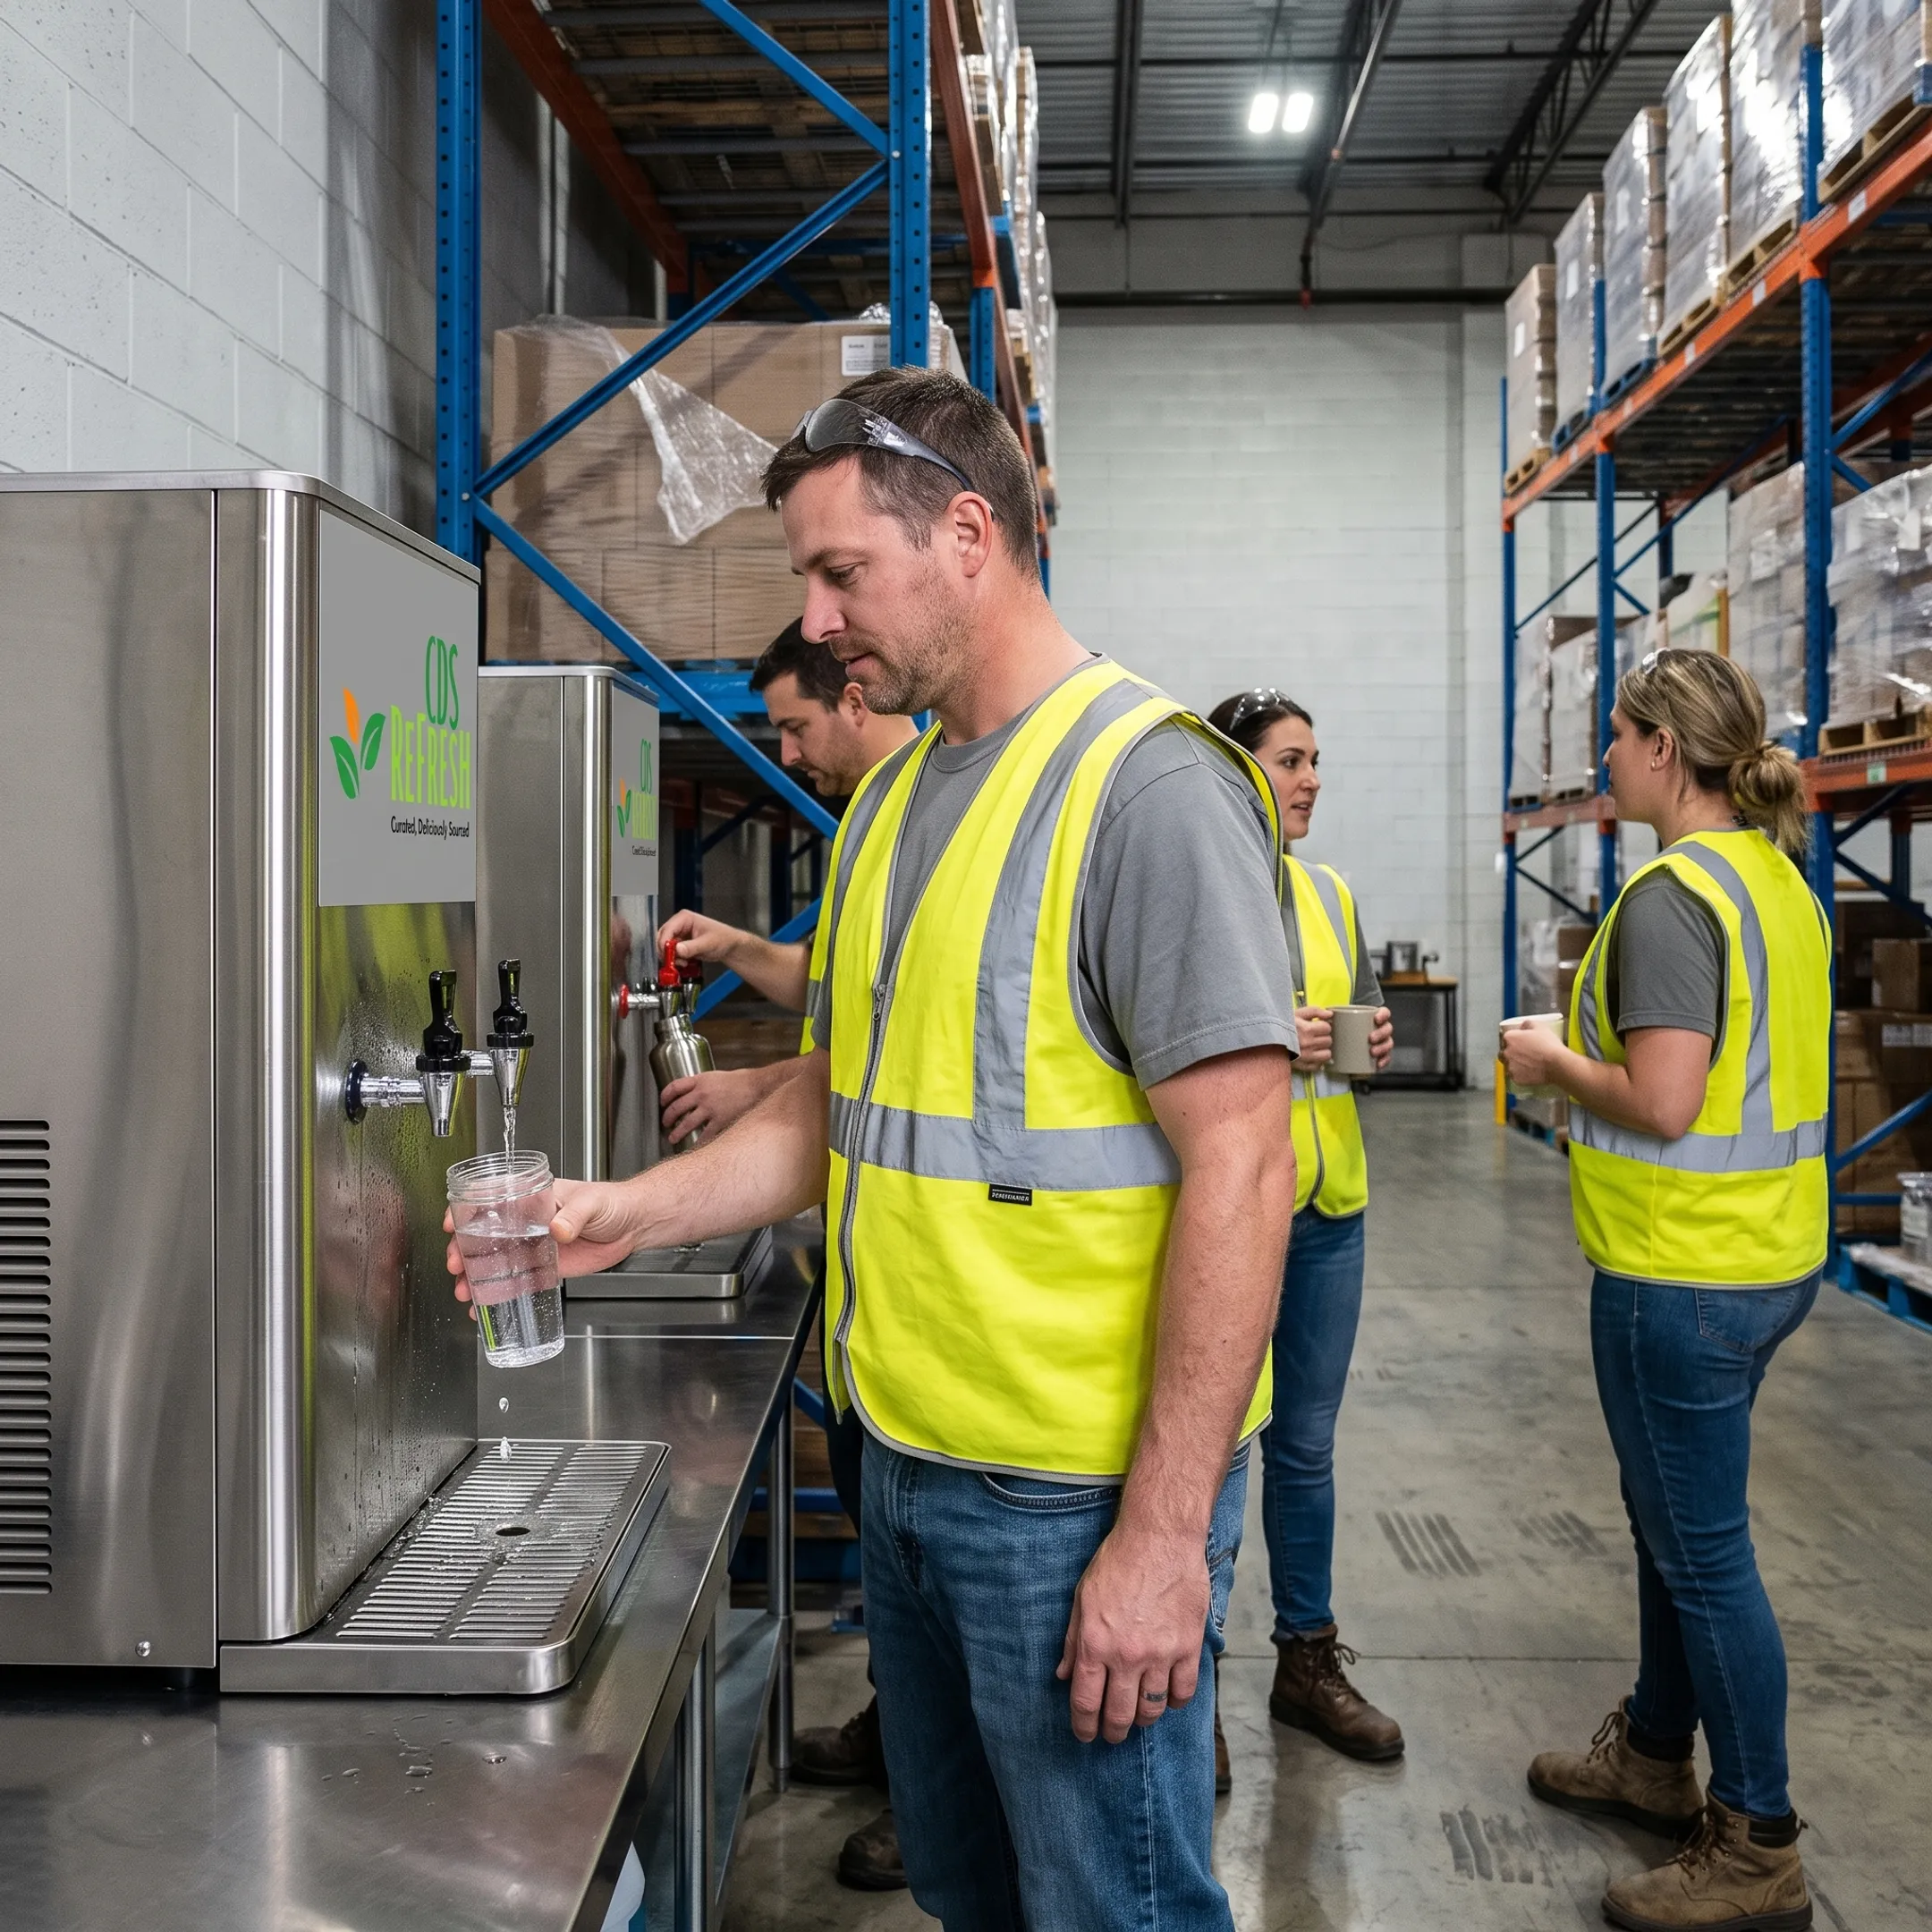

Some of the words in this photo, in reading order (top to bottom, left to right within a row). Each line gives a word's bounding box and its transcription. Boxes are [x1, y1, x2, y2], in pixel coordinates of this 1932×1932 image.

[425, 635, 460, 731] CDS
[390, 704, 471, 810] REFRESH
[390, 815, 418, 837] Curated,
[448, 821, 470, 838] Sourced
